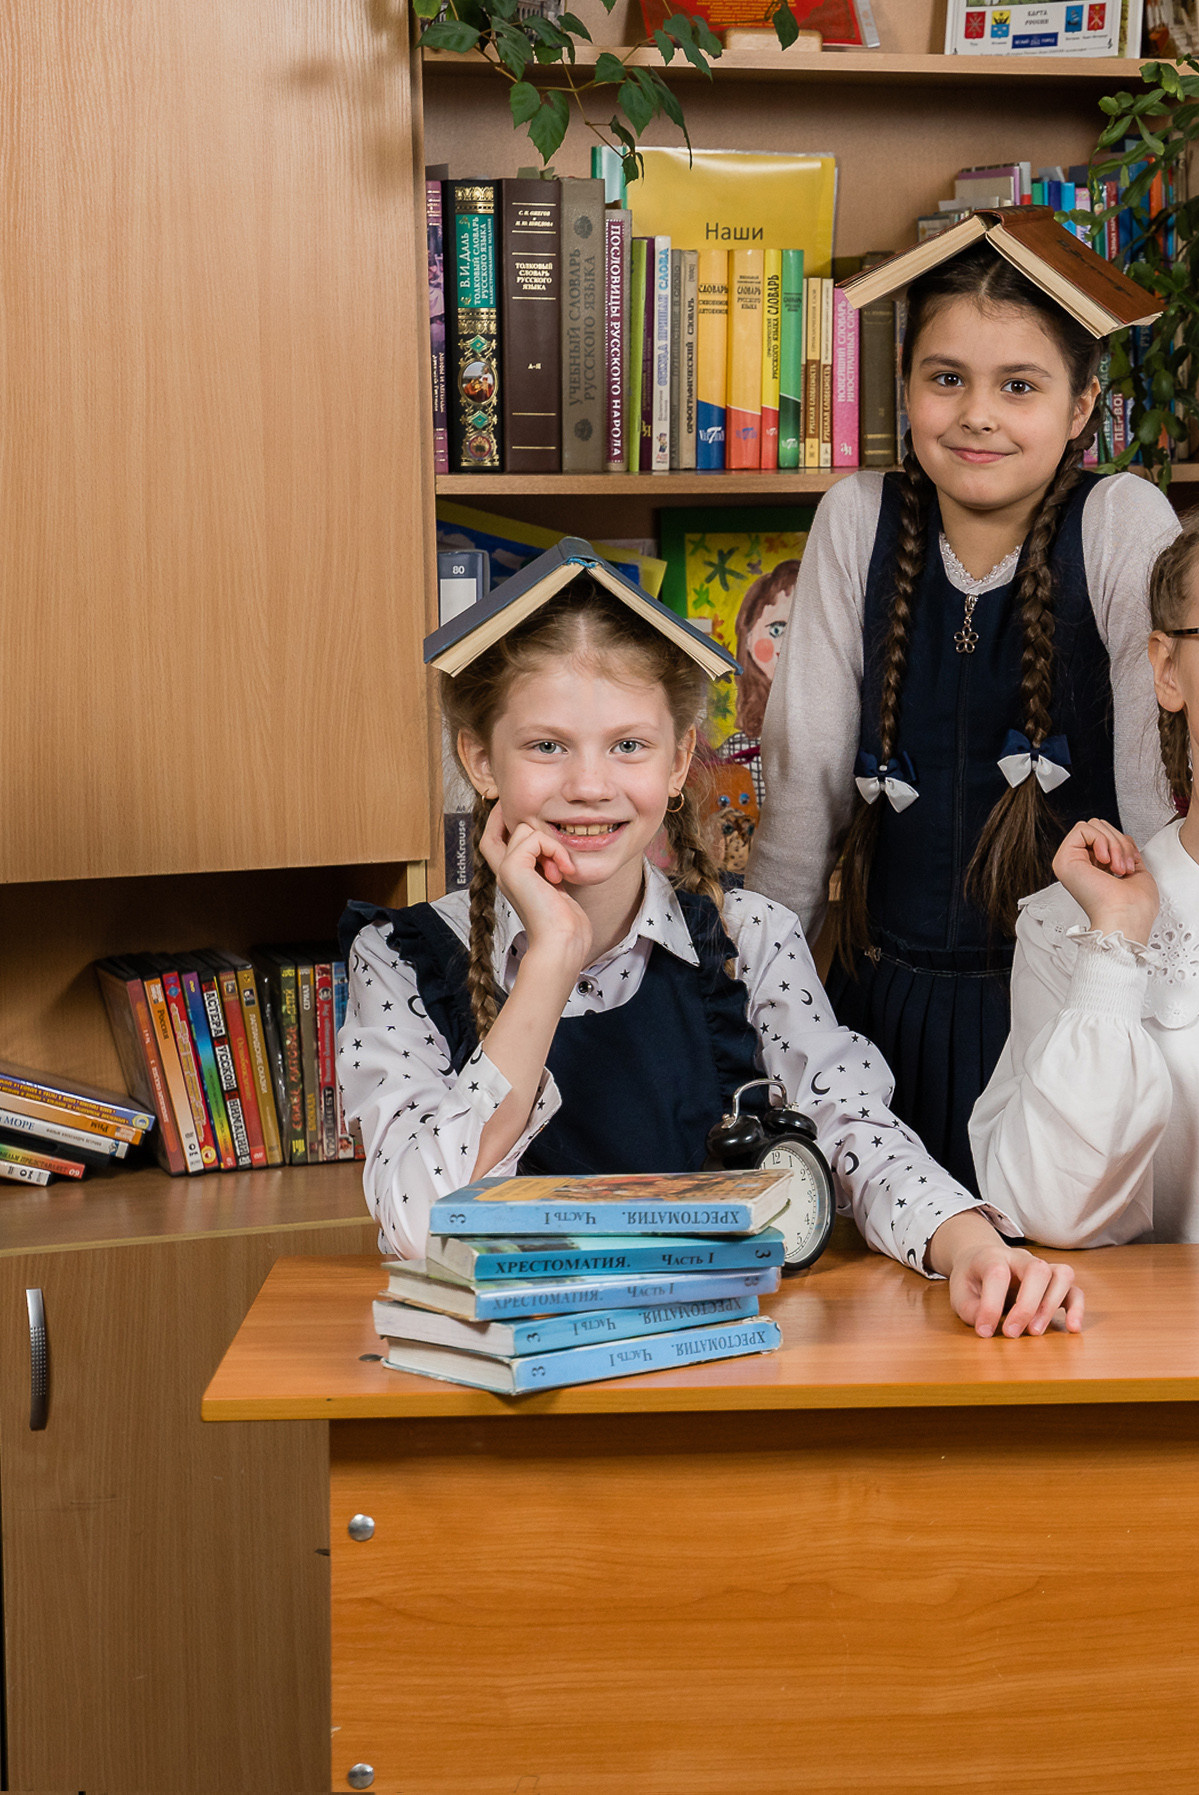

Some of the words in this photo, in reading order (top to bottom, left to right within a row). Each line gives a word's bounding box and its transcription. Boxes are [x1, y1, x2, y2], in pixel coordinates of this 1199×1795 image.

[472, 216, 480, 256] СЛОВАРЬ
[705, 222, 764, 241] Наши
[472, 257, 481, 305] ТОЛКОВЫЙ
[480, 254, 488, 299] РУССКОГО
[515, 262, 553, 270] ТОЛКОВЫЙ
[582, 255, 596, 311] ЯЗЫКА
[608, 225, 622, 317] ПОСЛОВИЦЫ
[658, 248, 669, 291] СЛОВА
[569, 248, 581, 322] СЛОВАРЬ
[767, 274, 780, 316] СЛОВАРЬ
[686, 297, 695, 336] СЛОВАРЬ
[837, 300, 847, 345] СЛОВАРЬ
[567, 327, 583, 407] УЧЕБНЫЙ
[582, 316, 597, 401] РУССКОГО
[609, 321, 621, 395] РУССКОГО
[835, 347, 846, 403] НОВЕЙШИЙ
[846, 331, 855, 403] ИНОСТРАННЫХ
[685, 341, 695, 434] ОРФОГРАФИЧЕСКИЙ
[610, 398, 621, 457] НАРОДА
[452, 565, 465, 575] 80
[456, 819, 467, 885] ErichKrause
[5, 1116, 35, 1131] МОРЕ
[771, 1151, 782, 1165] 12
[787, 1155, 794, 1168] 1
[799, 1169, 807, 1182] 2
[806, 1190, 814, 1204] 3
[450, 1213, 467, 1225] 3
[622, 1211, 740, 1225] ХРЕСТОМАТИЯ.
[804, 1212, 811, 1226] 4
[796, 1232, 803, 1246] 5
[495, 1256, 631, 1274] ХРЕСТОМАТИЯ.
[708, 1252, 715, 1265] I
[755, 1249, 772, 1260] 3
[493, 1289, 604, 1311] ХРЕСТОМАТИЯ.
[638, 1297, 743, 1326] ХРЕСТОМАТИЯ.
[526, 1332, 541, 1344] 3
[671, 1330, 767, 1357] ХРЕСТОМАТИЯ.
[531, 1365, 546, 1378] 3
